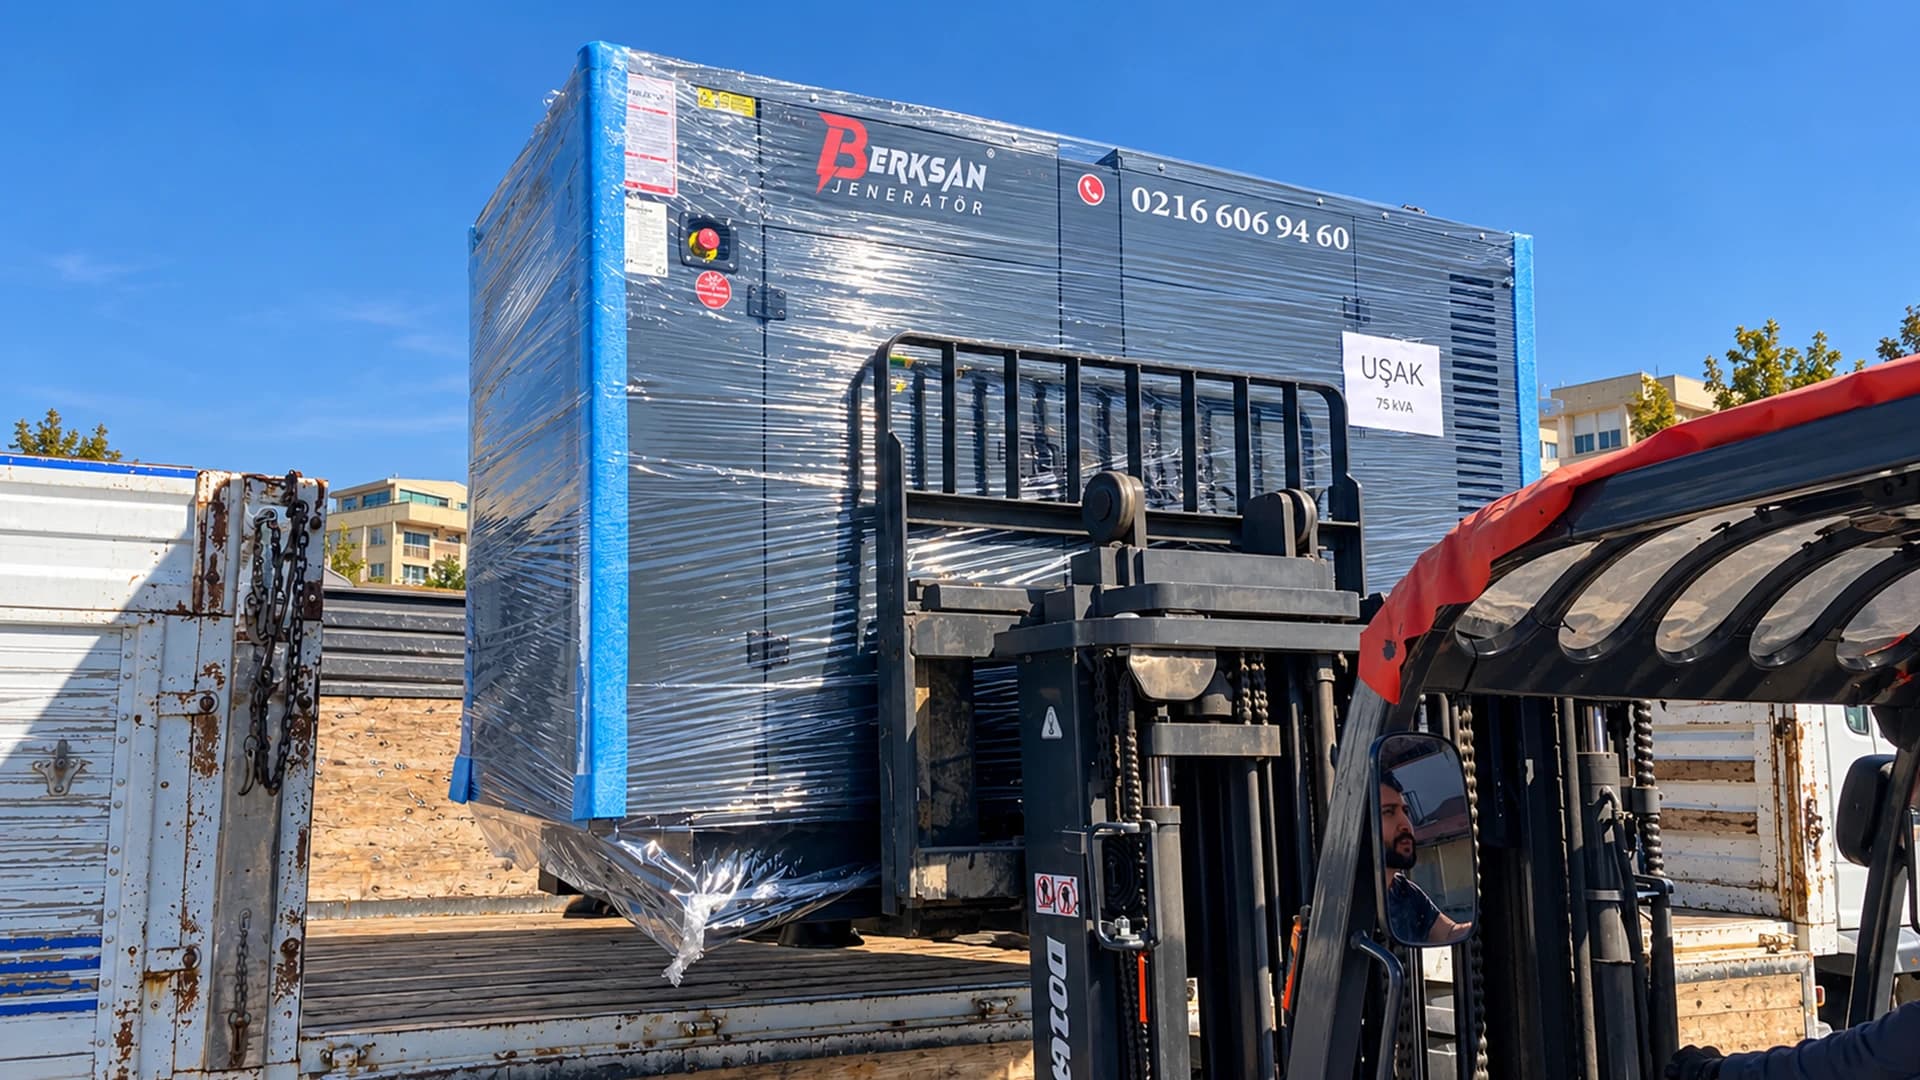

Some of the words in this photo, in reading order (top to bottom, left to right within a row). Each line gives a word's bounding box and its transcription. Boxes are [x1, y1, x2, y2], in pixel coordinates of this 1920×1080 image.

[816, 112, 987, 195] BERKSAN
[832, 180, 983, 215] JENERATÖR
[1131, 187, 1208, 223] 0216
[1215, 204, 1269, 235] 606
[1275, 215, 1310, 243] 94
[1316, 224, 1349, 250] 60
[1361, 355, 1424, 388] UŞAK
[1376, 397, 1390, 410] 75
[1392, 400, 1414, 413] kVA
